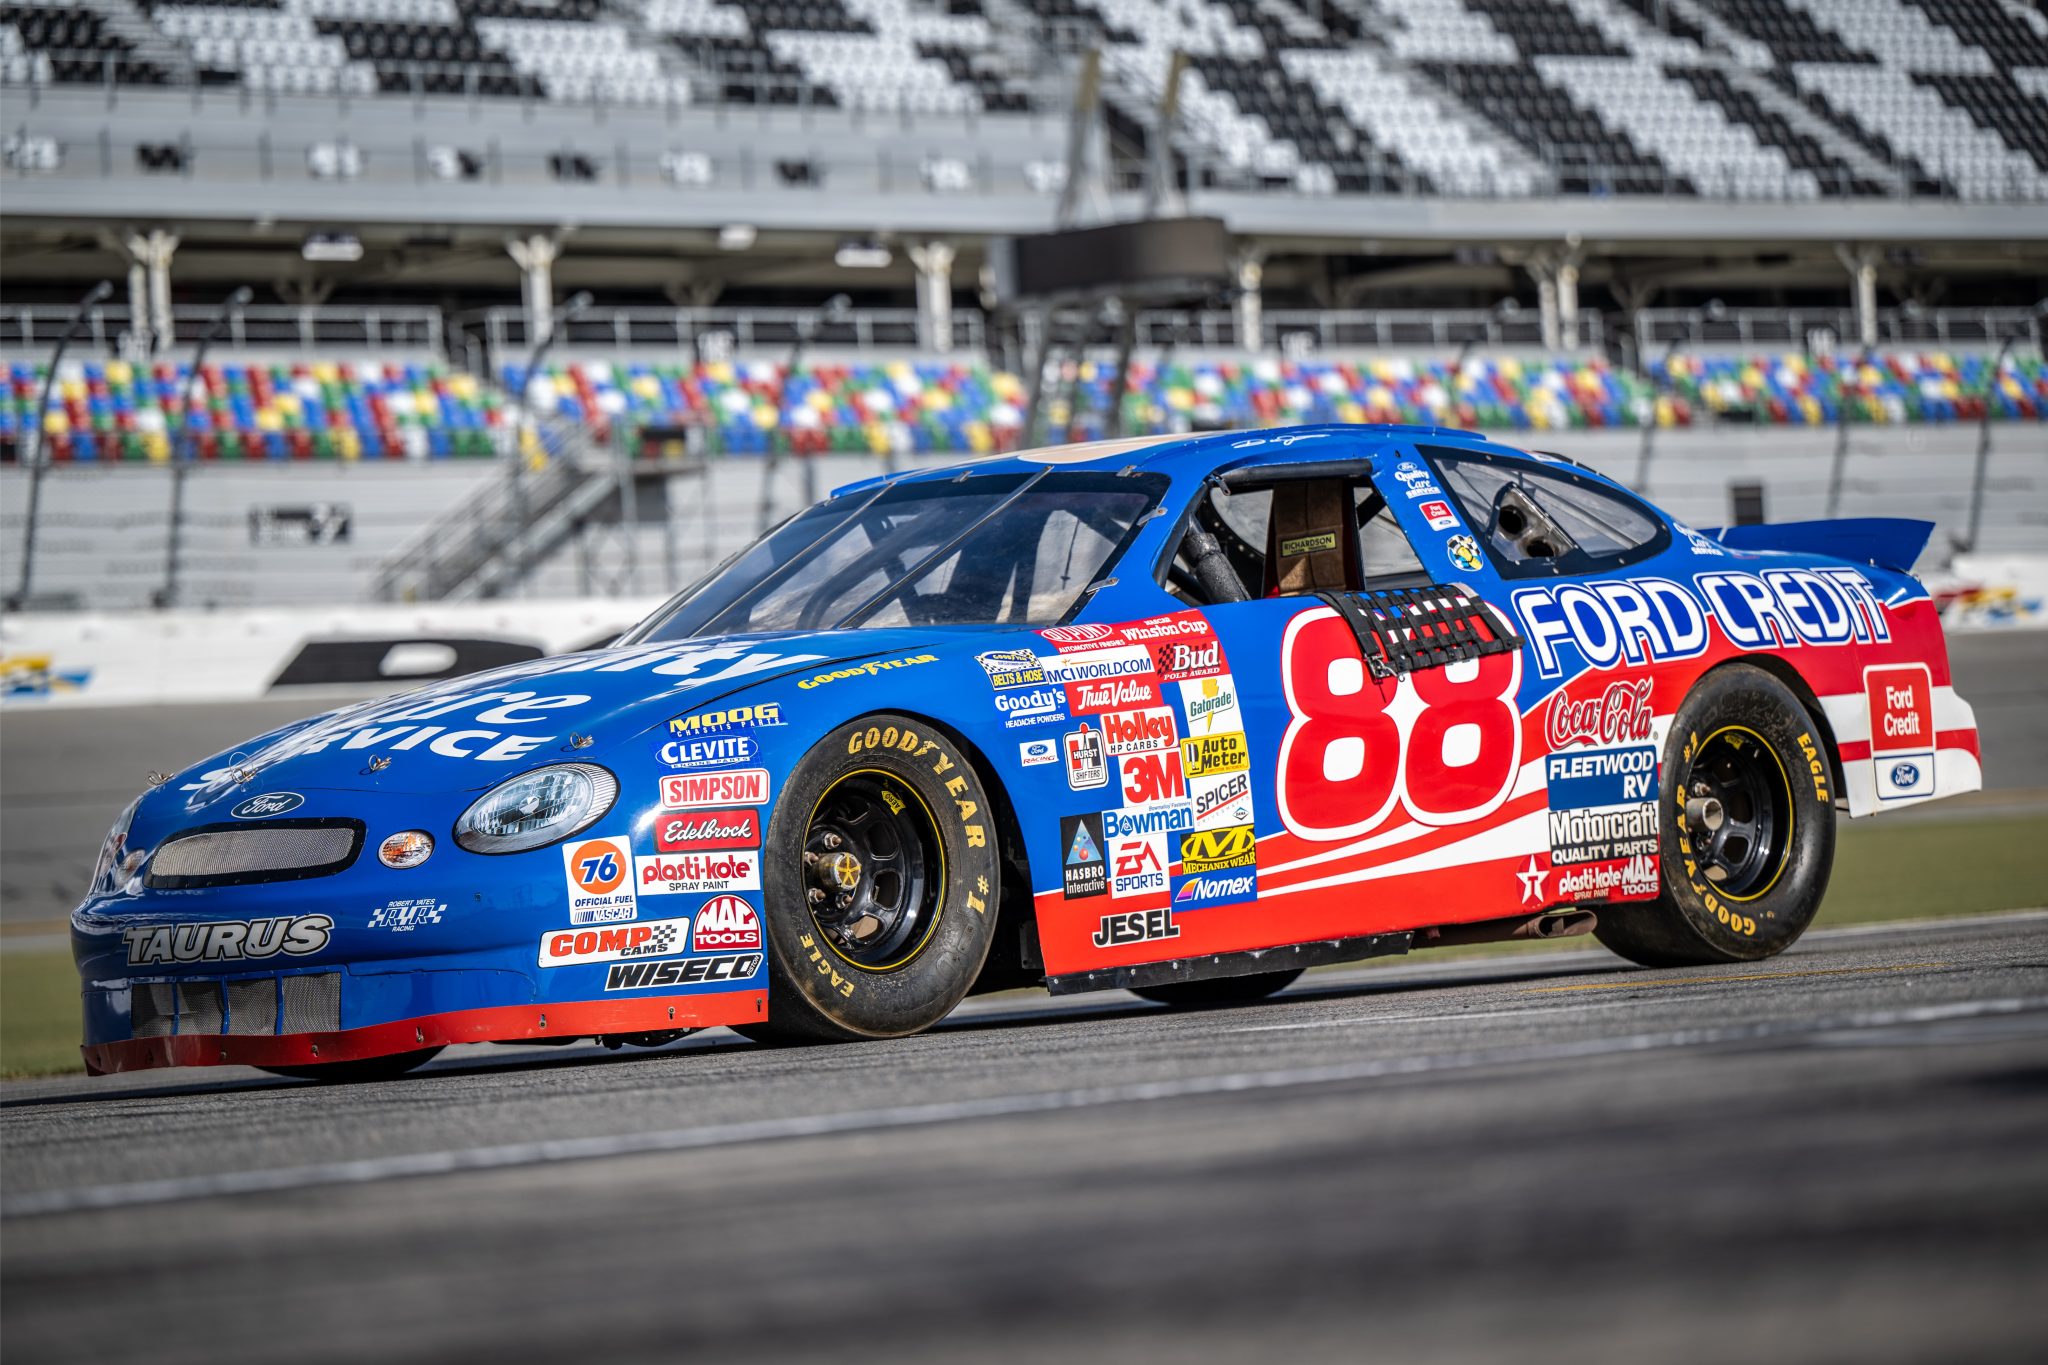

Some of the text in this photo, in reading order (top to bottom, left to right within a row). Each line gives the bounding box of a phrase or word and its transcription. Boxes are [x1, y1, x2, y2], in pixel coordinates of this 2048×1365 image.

[1284, 536, 1332, 550] RICHARDSON
[1120, 620, 1208, 640] Winston Cup
[1511, 576, 1710, 680] FORD
[1693, 566, 1892, 652] CREDIT
[1172, 641, 1221, 672] Bud
[797, 654, 940, 690] GOODYEAR
[993, 669, 1044, 686] BELTS & HOSE
[1164, 667, 1220, 681] POLE AWARD
[994, 687, 1066, 711] Goody's
[1190, 692, 1232, 718] Gatorade
[1885, 685, 1914, 709] Ford
[669, 703, 779, 732] MOOG
[676, 717, 780, 737] CHASSIS PARTS
[1005, 718, 1037, 728] HEADACHE
[1103, 712, 1175, 747] Holley
[1276, 602, 1523, 842] 88
[1884, 711, 1920, 737] Credit
[661, 737, 749, 763] CLEVITE
[1073, 748, 1098, 760] HURST
[1126, 740, 1158, 751] CARBS
[1202, 737, 1237, 754] Auto
[1201, 752, 1245, 770] Meter
[1550, 751, 1654, 780] FLEETWOOD
[1797, 731, 1829, 803] EAGLE
[1075, 769, 1101, 780] SHIFTERS
[1123, 751, 1185, 803] 3M
[1623, 772, 1653, 799] RV
[1893, 764, 1917, 786] Ford
[669, 775, 761, 803] SIMPSON
[848, 726, 986, 849] GOODYEAR
[1196, 773, 1248, 813] SPICER
[240, 794, 295, 815] Ford
[664, 818, 752, 843] Edelbrock
[1549, 803, 1658, 845] Motorcraft
[1182, 852, 1257, 875] MECHANIX WEAR
[1551, 839, 1658, 864] QUALITY PARTS
[579, 853, 619, 884] 76
[642, 855, 751, 885] plasti-kote
[1065, 866, 1104, 881] HASBRO
[1558, 865, 1621, 896] plasti-kote
[1621, 854, 1658, 884] MAC
[669, 881, 729, 891] SPRAY PAINT
[967, 874, 990, 914] #1
[1066, 878, 1105, 895] Interactive
[1116, 873, 1164, 892] SPORTS
[1194, 876, 1254, 901] Nomex
[1573, 888, 1610, 900] SPRAY PAINT
[1621, 882, 1659, 895] TOOLS
[575, 897, 612, 907] OFFICIAL
[614, 895, 634, 904] FUEL
[700, 898, 758, 932] MAC
[1093, 910, 1180, 945] JESEL
[122, 913, 335, 966] TAURUS
[549, 926, 654, 957] COMP
[620, 943, 669, 957] CAMS
[696, 932, 757, 945] TOOLS
[605, 955, 757, 990] WISECO
[746, 955, 760, 976] PISTON
[800, 932, 855, 998] EAGLE
